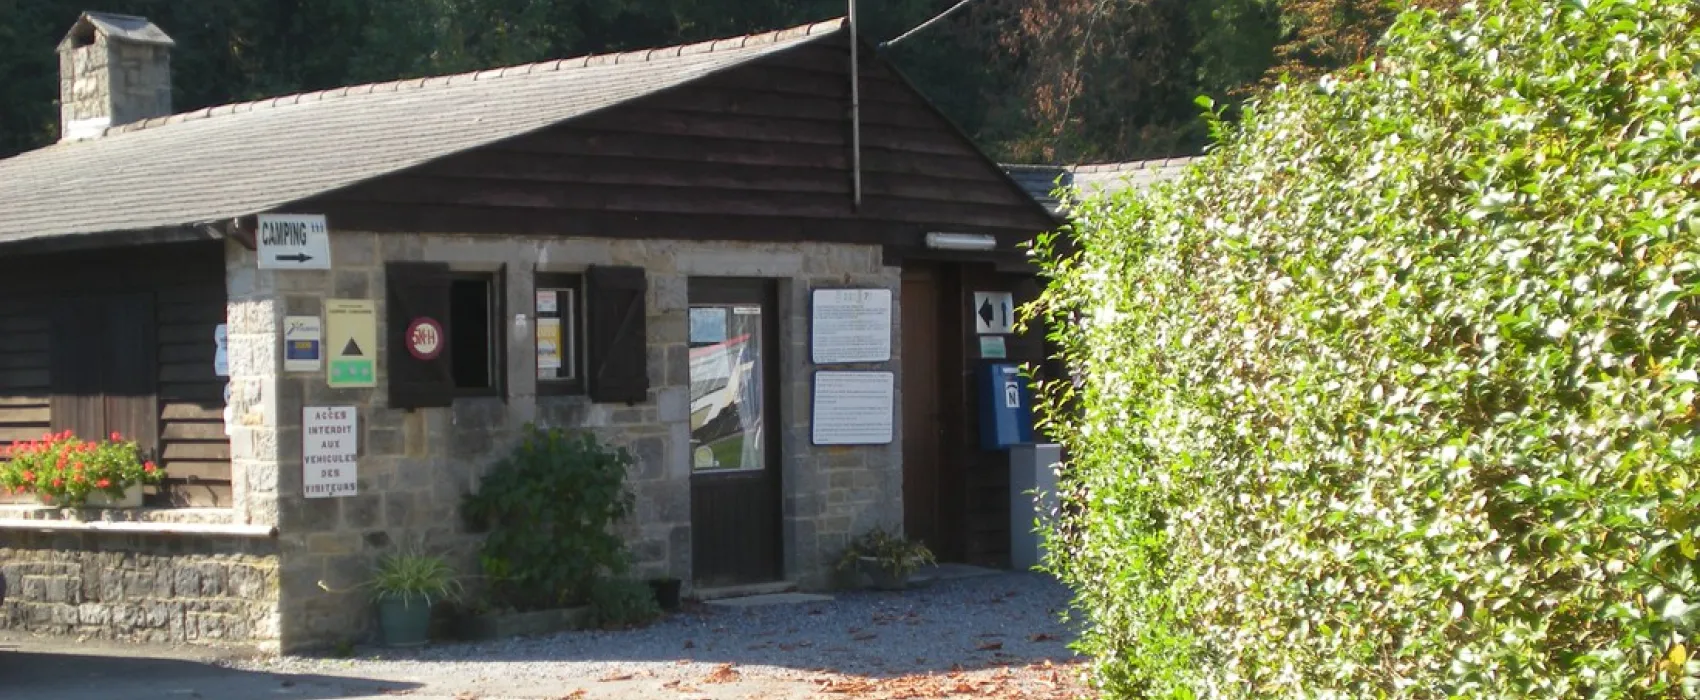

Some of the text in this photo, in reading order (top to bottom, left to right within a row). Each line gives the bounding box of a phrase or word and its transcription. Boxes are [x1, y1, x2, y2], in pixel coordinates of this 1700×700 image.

[263, 221, 307, 246] CAMPING
[308, 425, 352, 435] INTERDIT
[321, 440, 340, 448] AUX
[305, 453, 357, 464] VEHICULES
[321, 469, 340, 478] DES
[305, 482, 355, 492] VISITEURS
